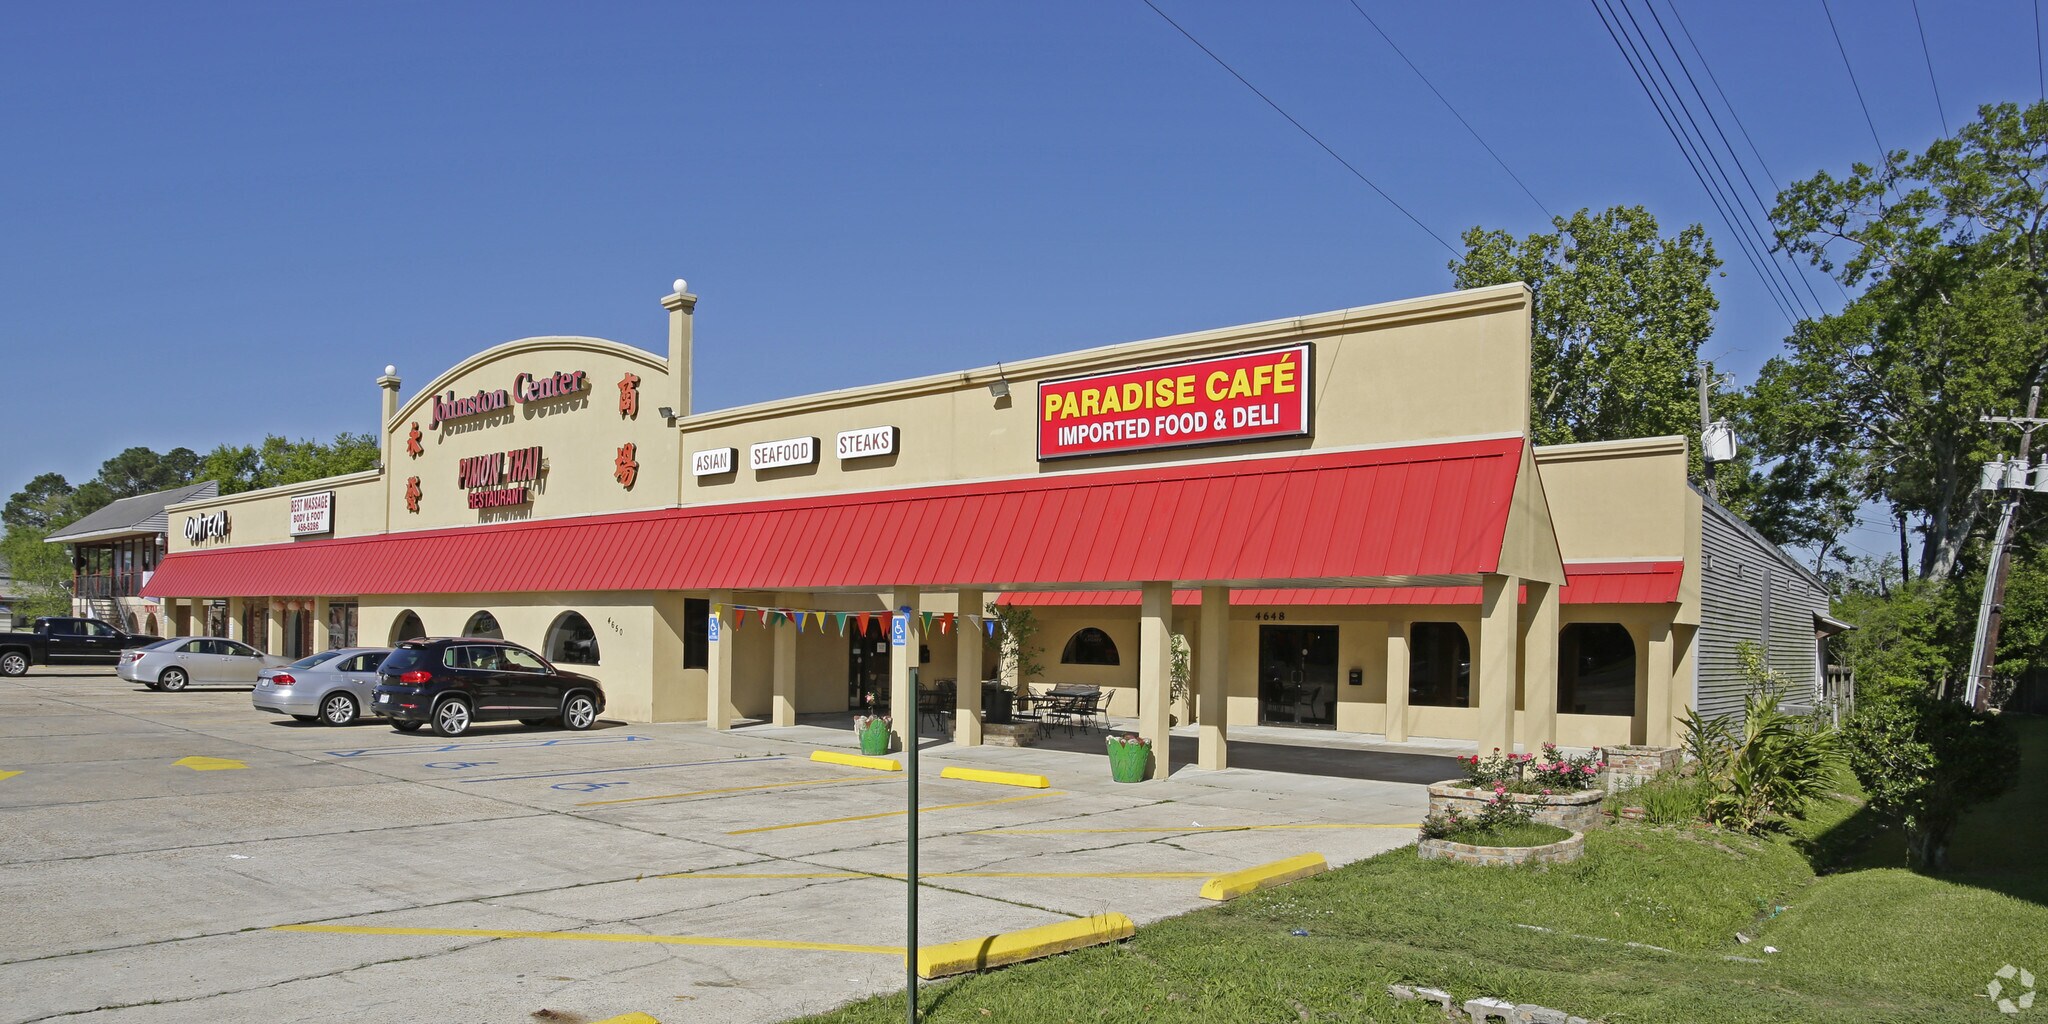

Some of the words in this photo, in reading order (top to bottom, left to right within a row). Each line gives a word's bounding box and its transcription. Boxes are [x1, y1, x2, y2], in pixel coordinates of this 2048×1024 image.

[1044, 374, 1197, 422] PARADISE
[1204, 353, 1297, 402] CAFÉ
[429, 390, 507, 430] Johnston
[513, 370, 585, 404] Center
[1058, 417, 1151, 446] IMPORTED
[1155, 411, 1208, 437] FOOD
[1213, 408, 1227, 431] &
[1232, 402, 1280, 429] DELI
[754, 442, 808, 465] SEAFOOD
[839, 431, 889, 454] STEAKS
[458, 452, 502, 489] PIMON
[507, 446, 542, 483] THAI
[696, 452, 727, 472] ASIAN
[291, 499, 303, 513] BEST
[304, 495, 328, 511] MASSAGE
[468, 487, 527, 509] RESTAURANT
[184, 510, 227, 541] COMTECH
[294, 514, 305, 523] BODY
[306, 512, 310, 522] &
[311, 511, 324, 521] FOOT
[607, 616, 624, 636] 4650
[1255, 611, 1285, 621] 4648
